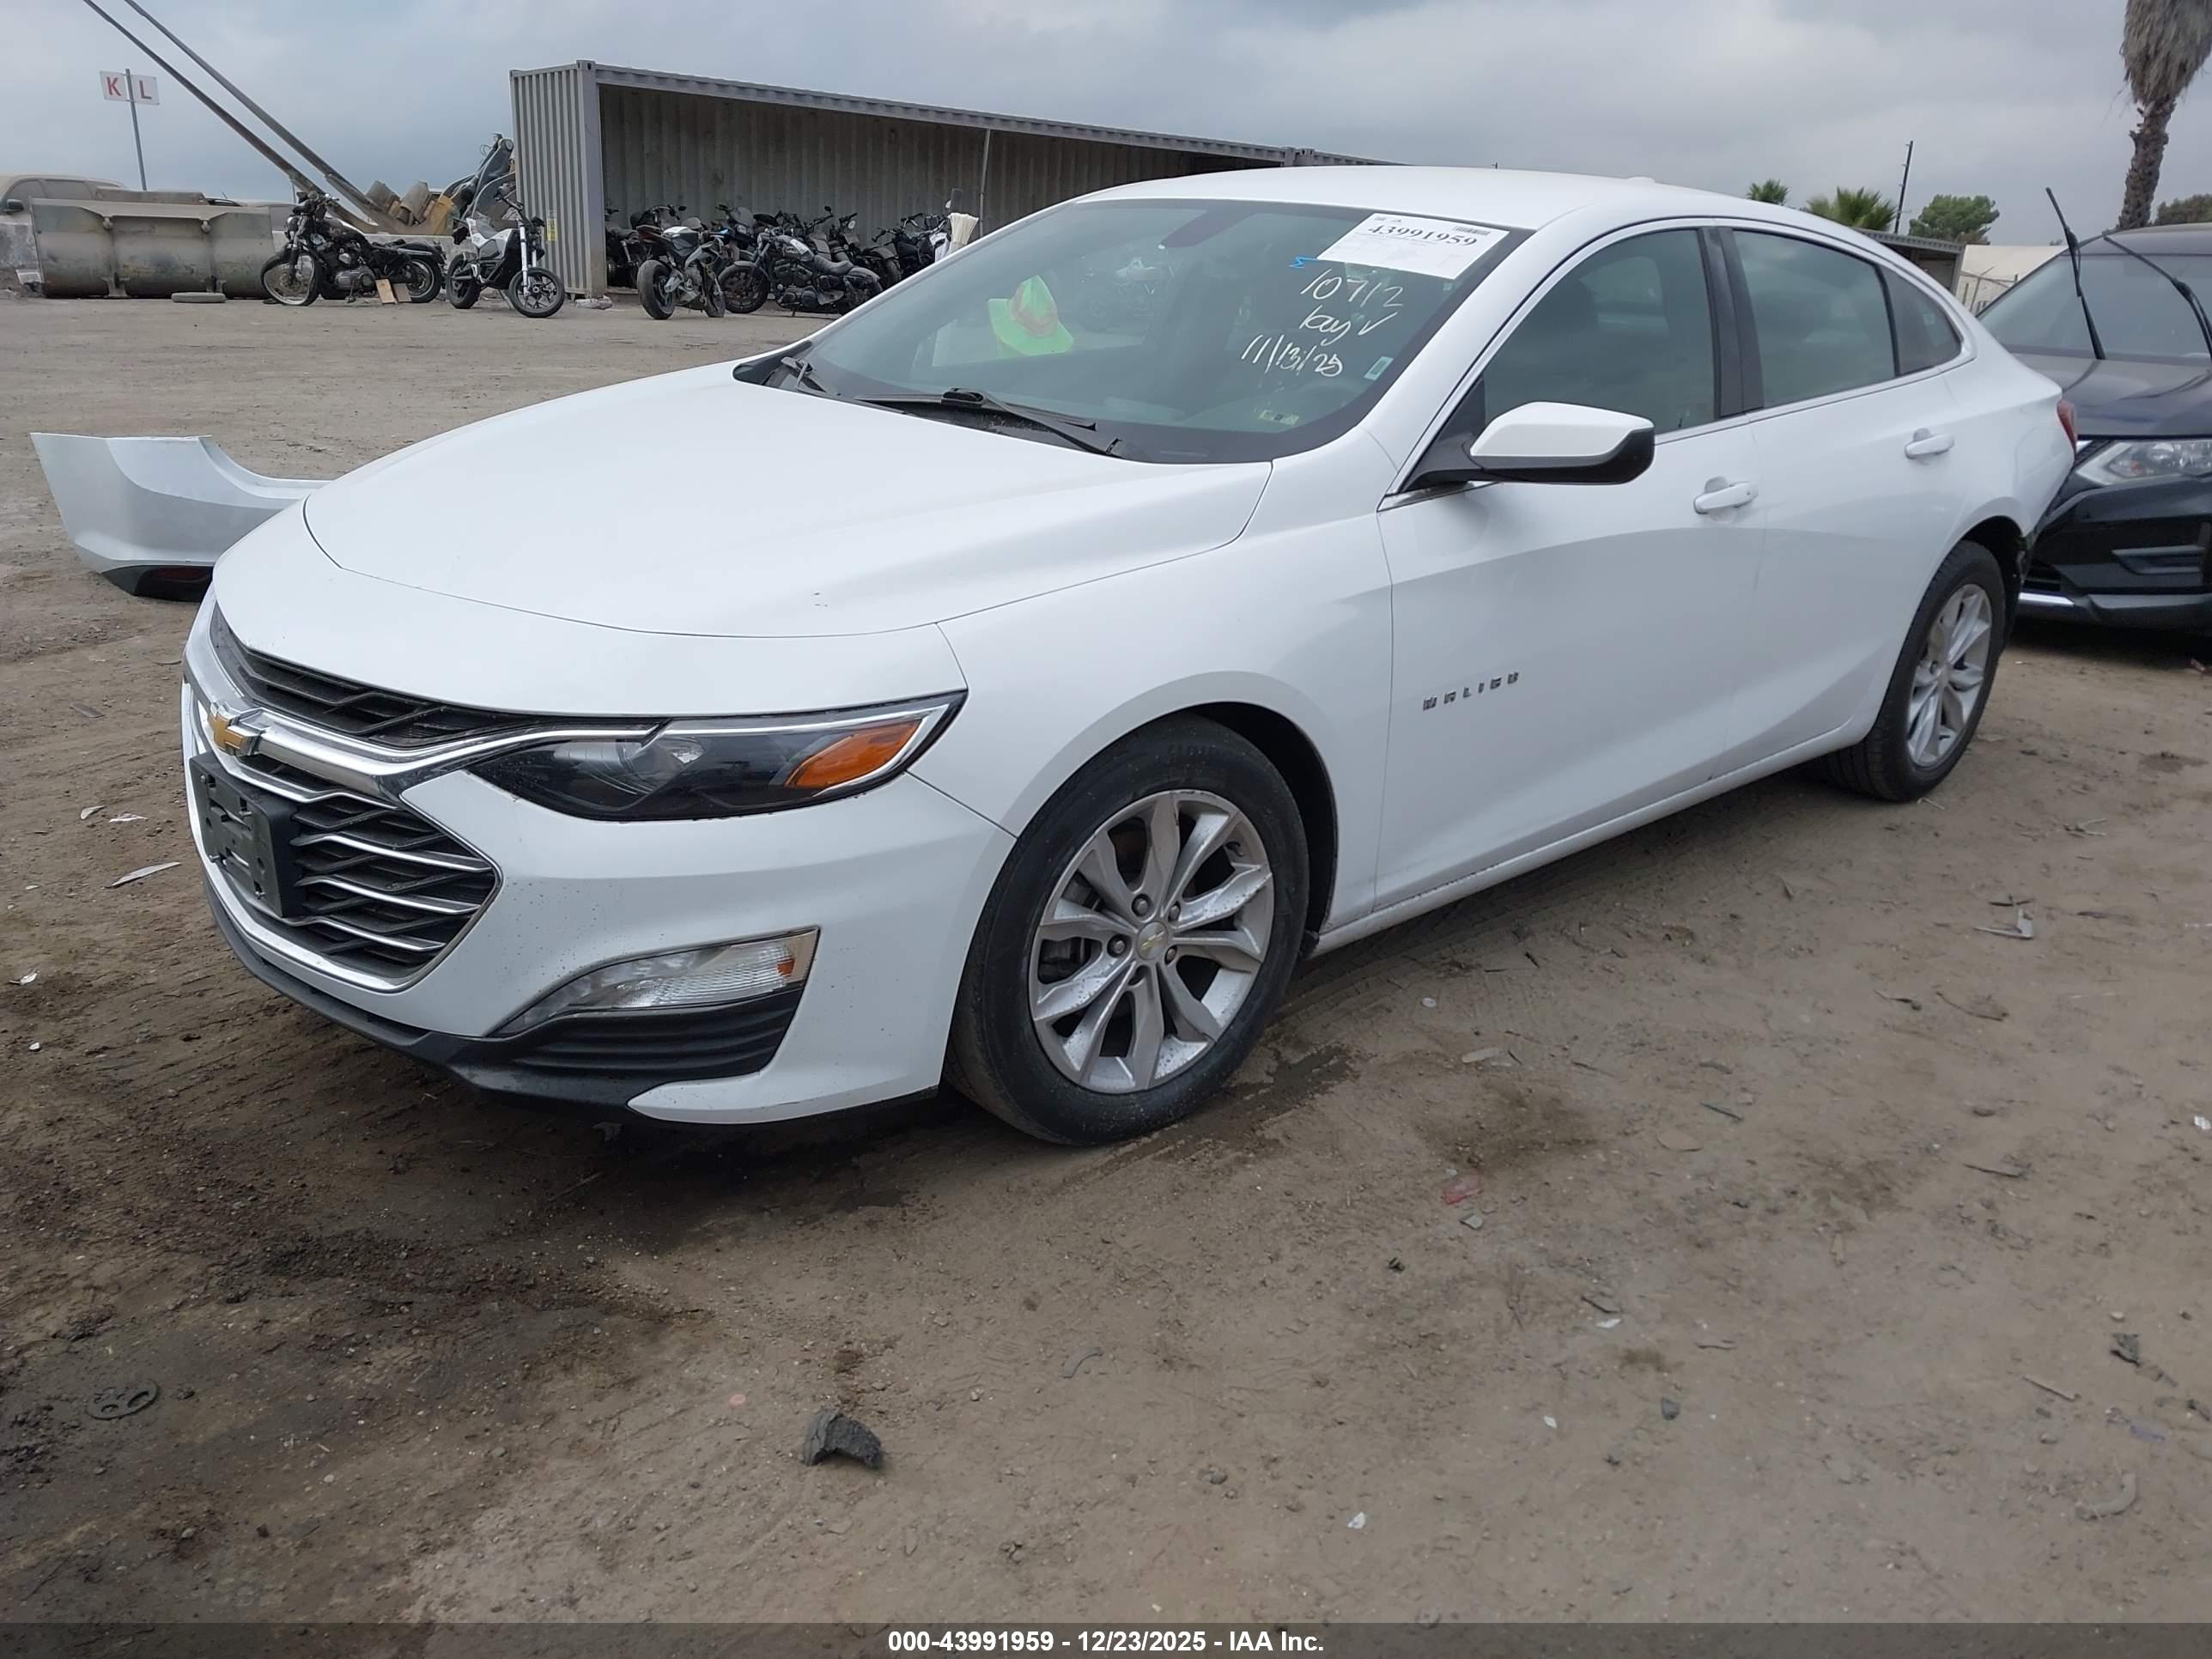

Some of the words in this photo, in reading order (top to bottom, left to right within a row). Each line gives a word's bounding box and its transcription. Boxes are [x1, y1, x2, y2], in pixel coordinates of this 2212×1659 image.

[106, 76, 122, 96] K
[138, 80, 152, 100] L
[1368, 224, 1478, 246] 43991959
[1422, 672, 1519, 711] MALIBU
